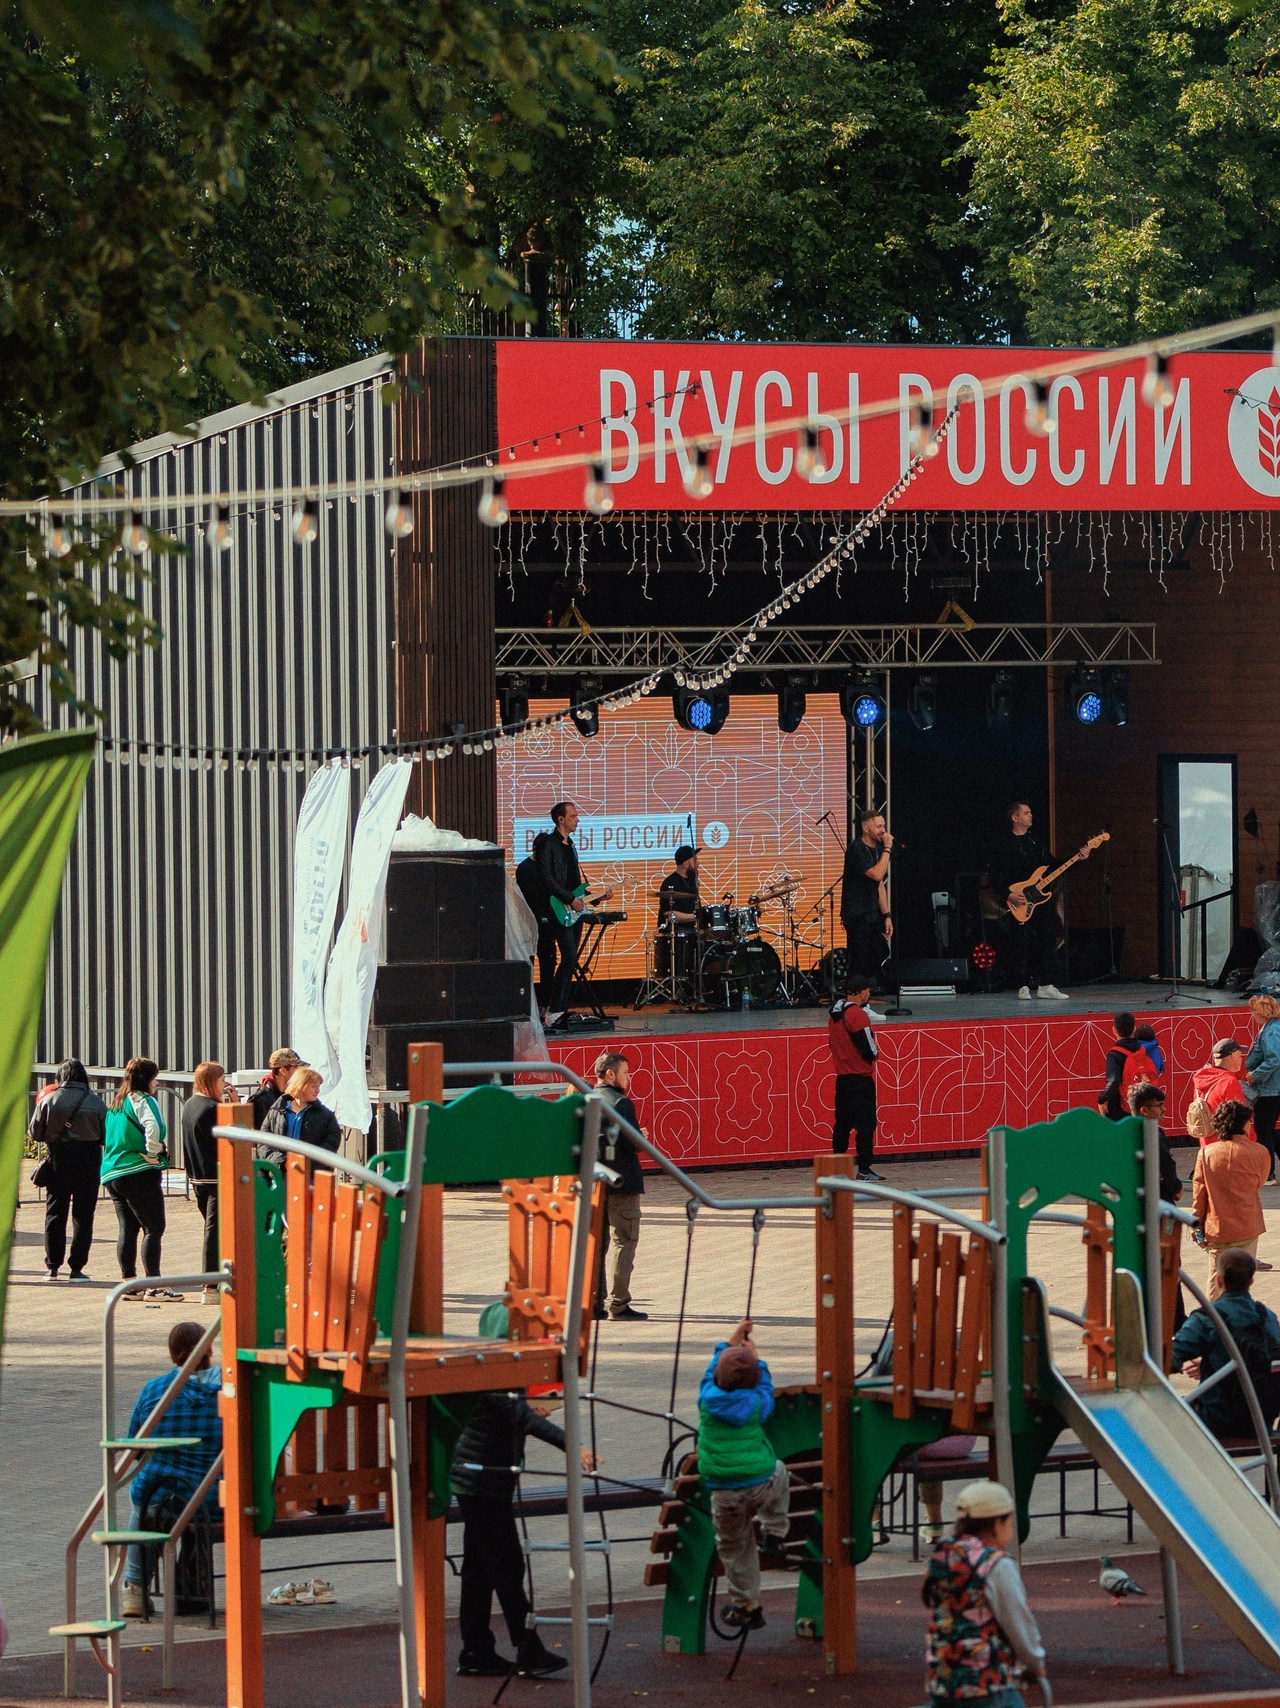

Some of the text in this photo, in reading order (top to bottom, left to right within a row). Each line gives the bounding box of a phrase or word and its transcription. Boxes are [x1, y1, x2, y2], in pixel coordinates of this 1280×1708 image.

[600, 369, 1191, 486] ВКУСЫ РОССИИ
[603, 825, 684, 850] РОССИИ
